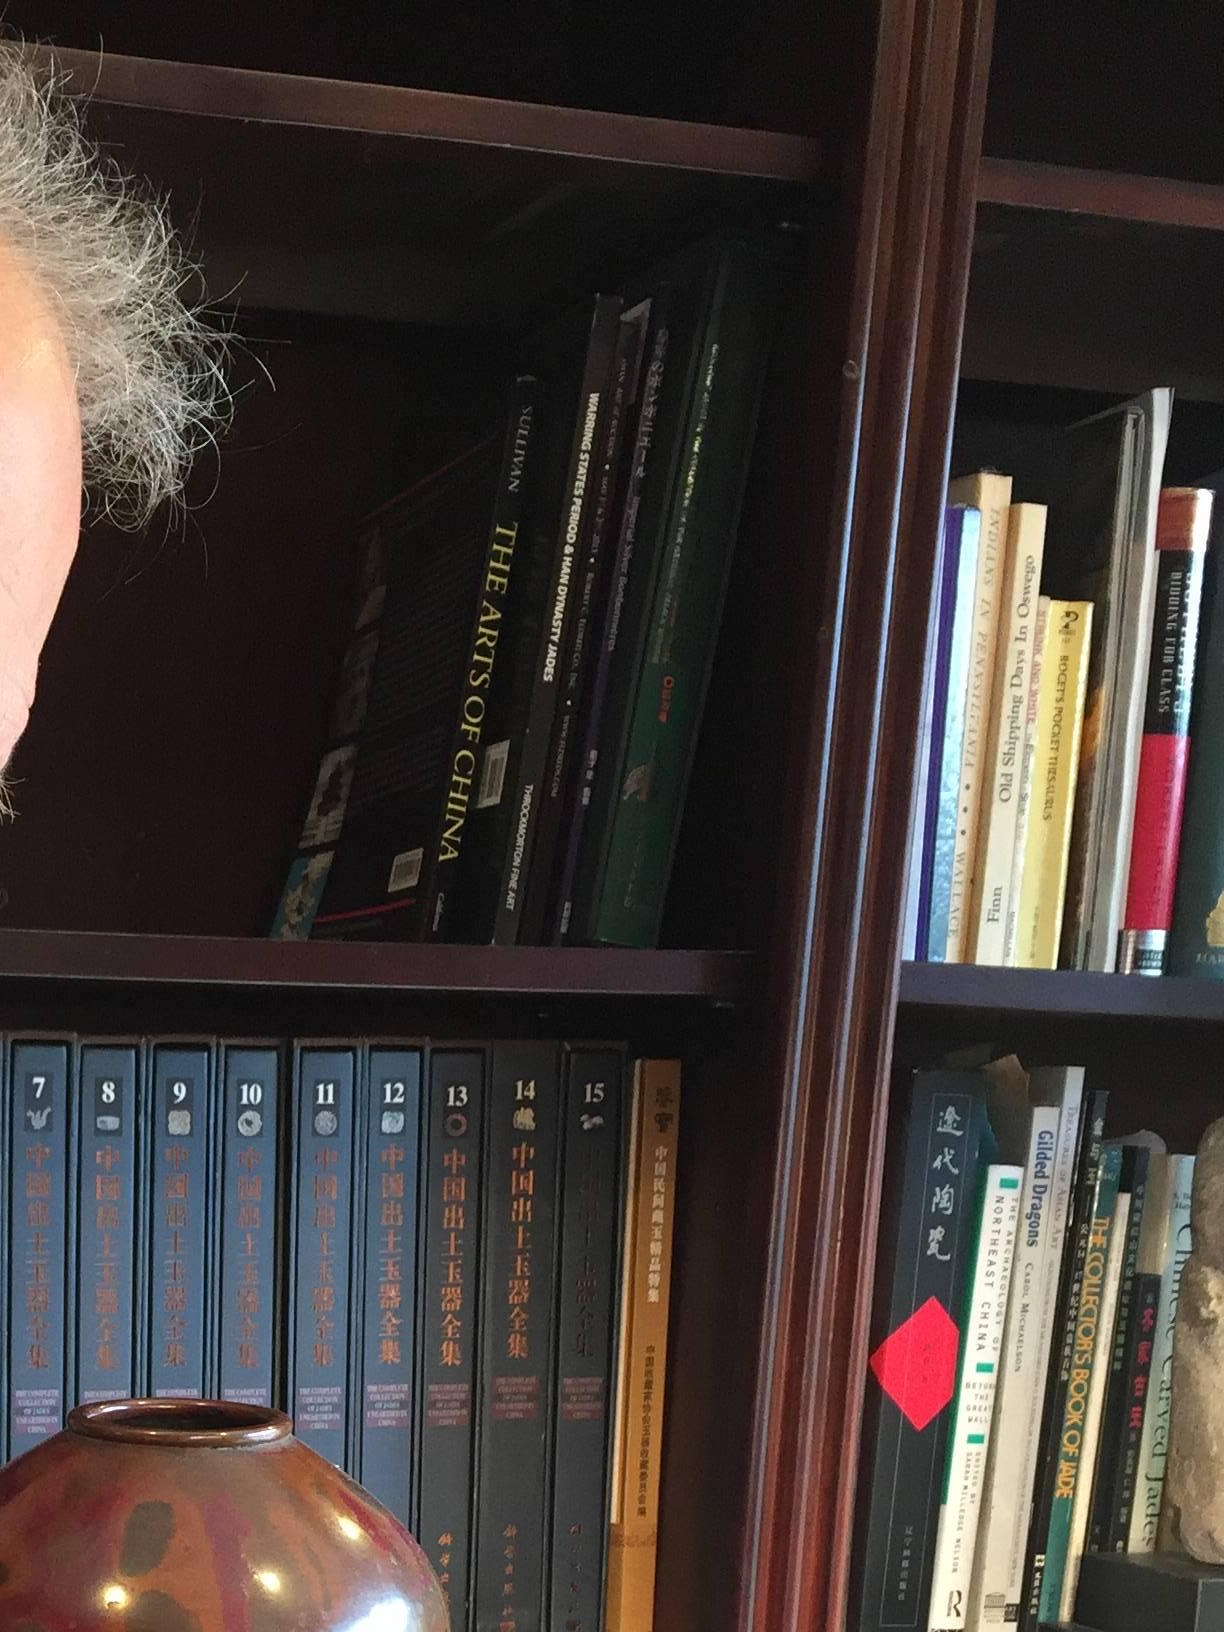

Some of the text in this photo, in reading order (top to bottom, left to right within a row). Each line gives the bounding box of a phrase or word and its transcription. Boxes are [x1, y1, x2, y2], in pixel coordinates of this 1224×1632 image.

[508, 405, 534, 493] SULLIVAN
[543, 392, 601, 683] WARRING STATES PERIOD & HAN DYNASTY JADES
[983, 507, 1001, 586] INDIANS
[999, 555, 1037, 804] Old Shipping Days In Oswego
[1054, 655, 1070, 703] ROGET'S
[1157, 571, 1183, 714] BIDDING FOR CLASS
[438, 521, 519, 863] THE ARTS OF CHINA
[1047, 705, 1064, 752] POCKET
[1042, 755, 1059, 821] THESAURUS
[505, 784, 534, 912] THROCKMORTON FINE ART
[948, 852, 967, 939] WALLACE
[987, 886, 1004, 924] Finn
[32, 1077, 47, 1099] 7
[101, 1081, 116, 1104] 8
[173, 1082, 187, 1104] 9
[240, 1083, 262, 1105] 10
[316, 1083, 335, 1105] 11
[383, 1082, 405, 1104] 12
[447, 1085, 468, 1107] 13
[515, 1079, 536, 1101] 14
[583, 1081, 606, 1103] 15
[1032, 1130, 1055, 1181] Gilded
[26, 1141, 52, 1369] 中国出土玉器全集
[95, 1144, 121, 1371] 中国出土玉器全集
[164, 1143, 190, 1367] 中国出土玉器全集
[237, 1145, 263, 1368] 中国出土玉器全集
[379, 1143, 406, 1365] 中国出土玉器全集
[441, 1148, 467, 1367] 中国出土玉器全集
[507, 1141, 536, 1359] 中国出土玉器全集
[1025, 1184, 1048, 1249] Dragons
[976, 1195, 1005, 1351] NORTHEAST CHINA
[991, 1195, 1019, 1353] THE ARCHAEOLOGY OF
[1055, 1216, 1110, 1500] THE COLLECTOR'S BOOK OF JADE
[1141, 1472, 1165, 1547] Jades
